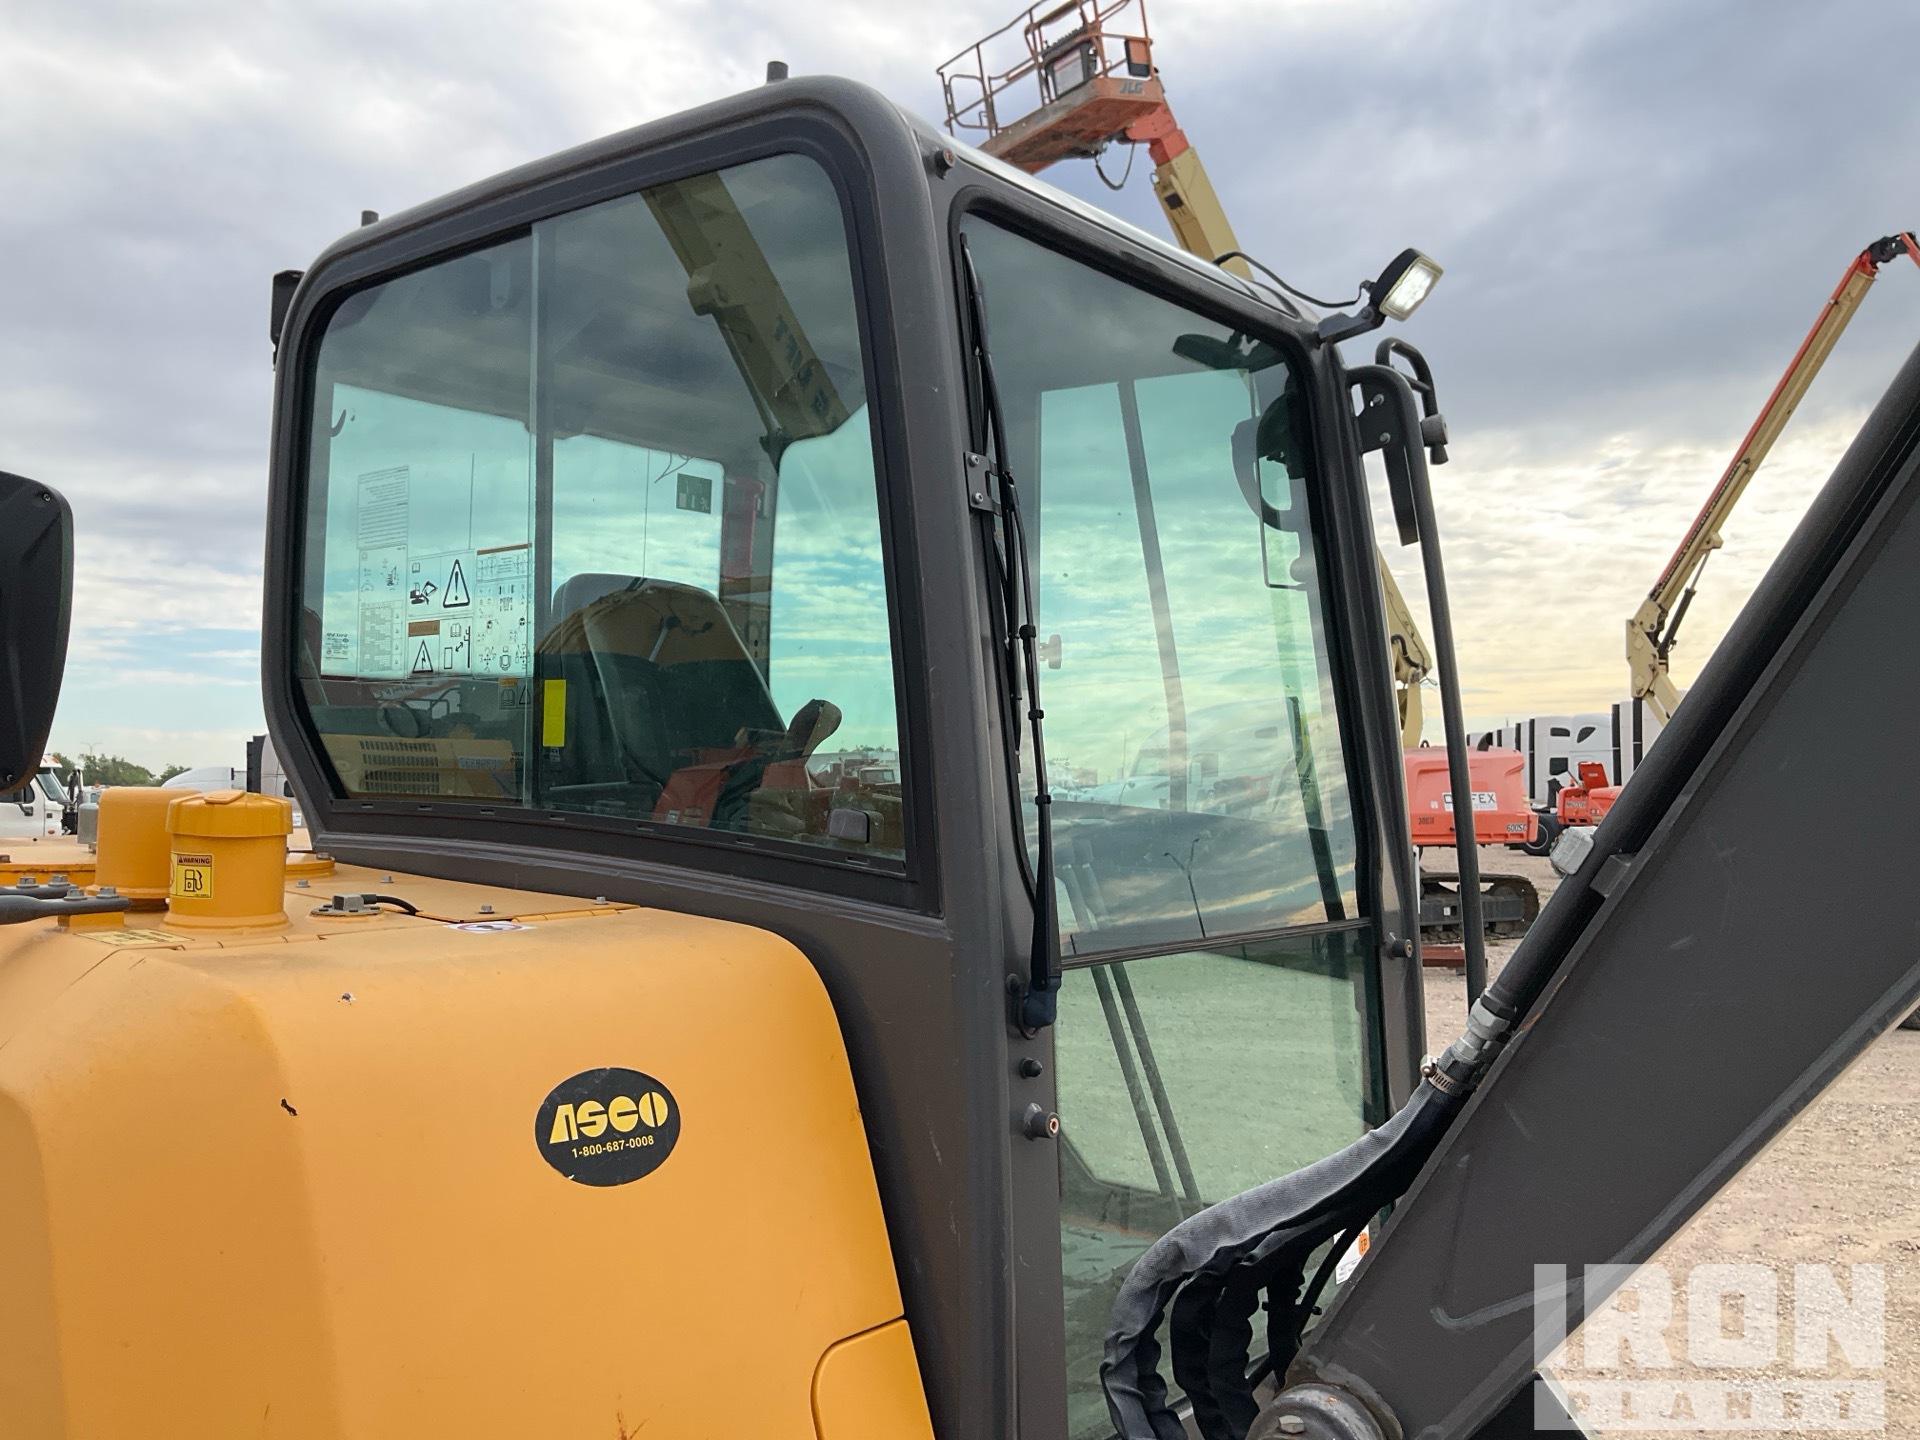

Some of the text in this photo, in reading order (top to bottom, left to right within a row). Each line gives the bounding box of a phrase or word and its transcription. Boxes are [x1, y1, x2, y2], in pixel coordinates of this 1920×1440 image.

[1120, 80, 1144, 95] JLG
[182, 857, 211, 865] WARNING
[550, 1091, 668, 1144] ASCO
[571, 1135, 654, 1158] 1-800-687-0008
